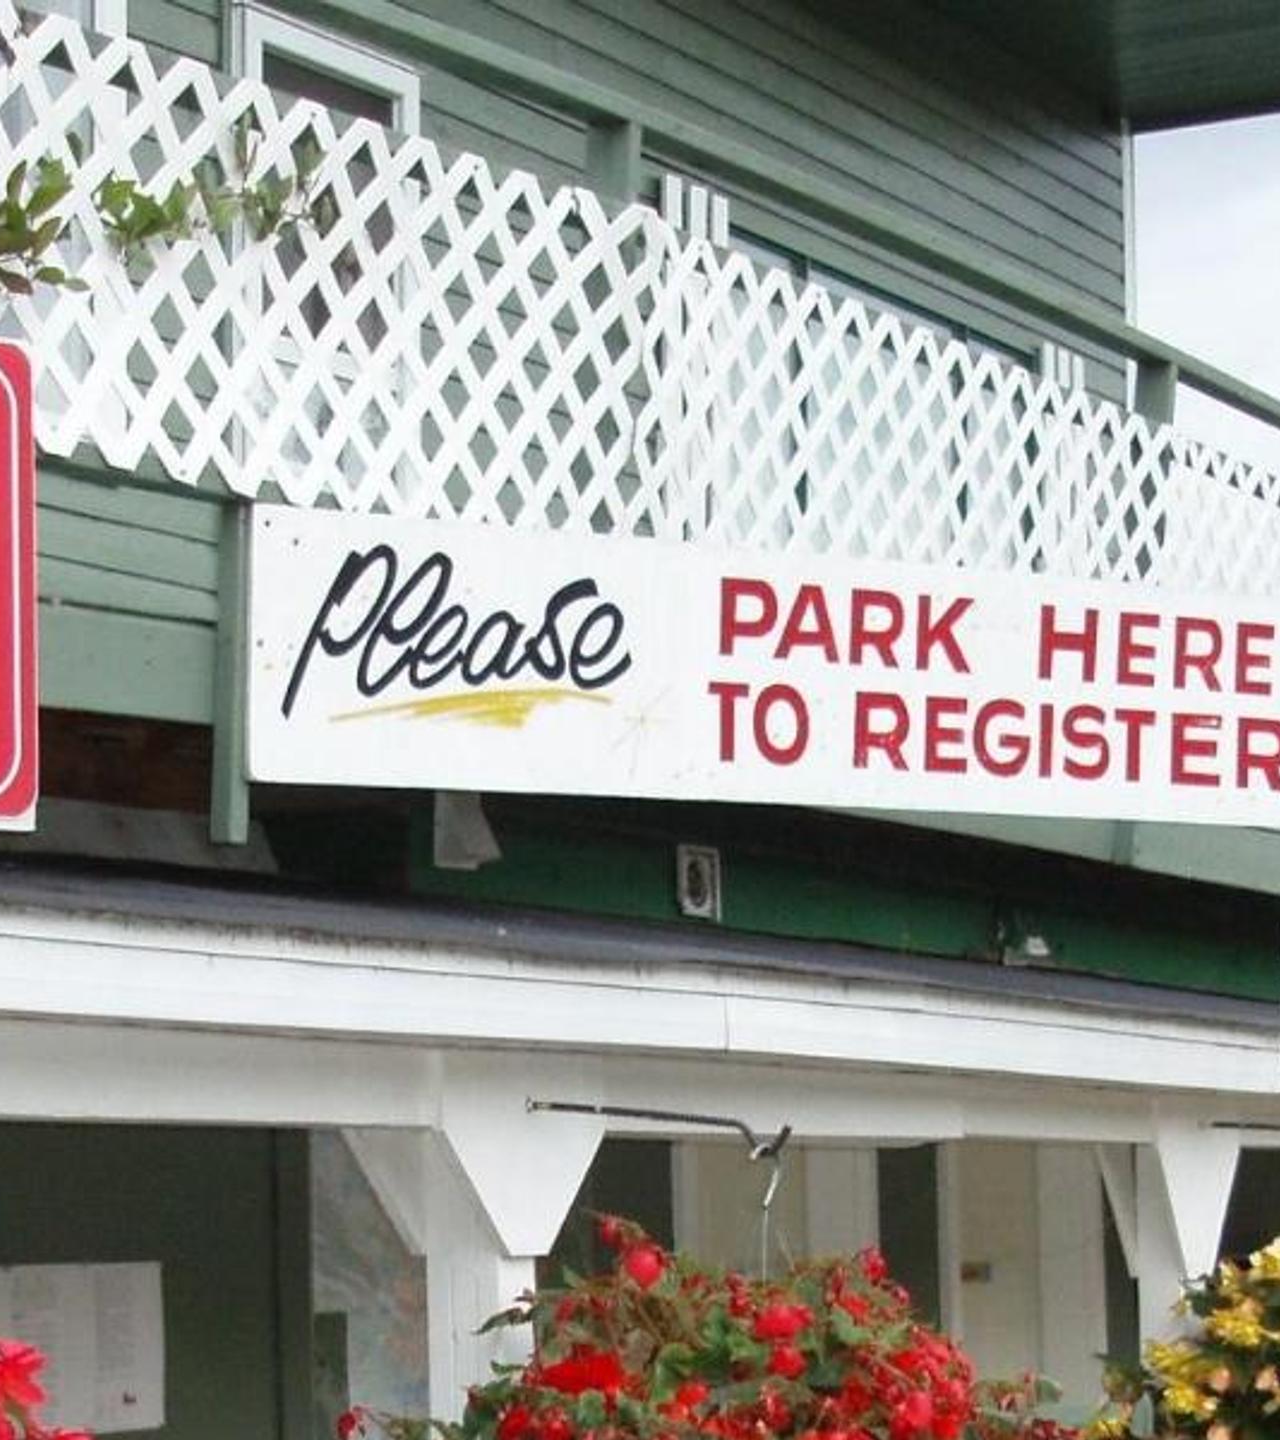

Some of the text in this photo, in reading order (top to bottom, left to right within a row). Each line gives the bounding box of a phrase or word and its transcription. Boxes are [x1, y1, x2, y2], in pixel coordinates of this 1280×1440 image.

[719, 576, 1276, 695] PARK HERE
[707, 680, 811, 766] TO
